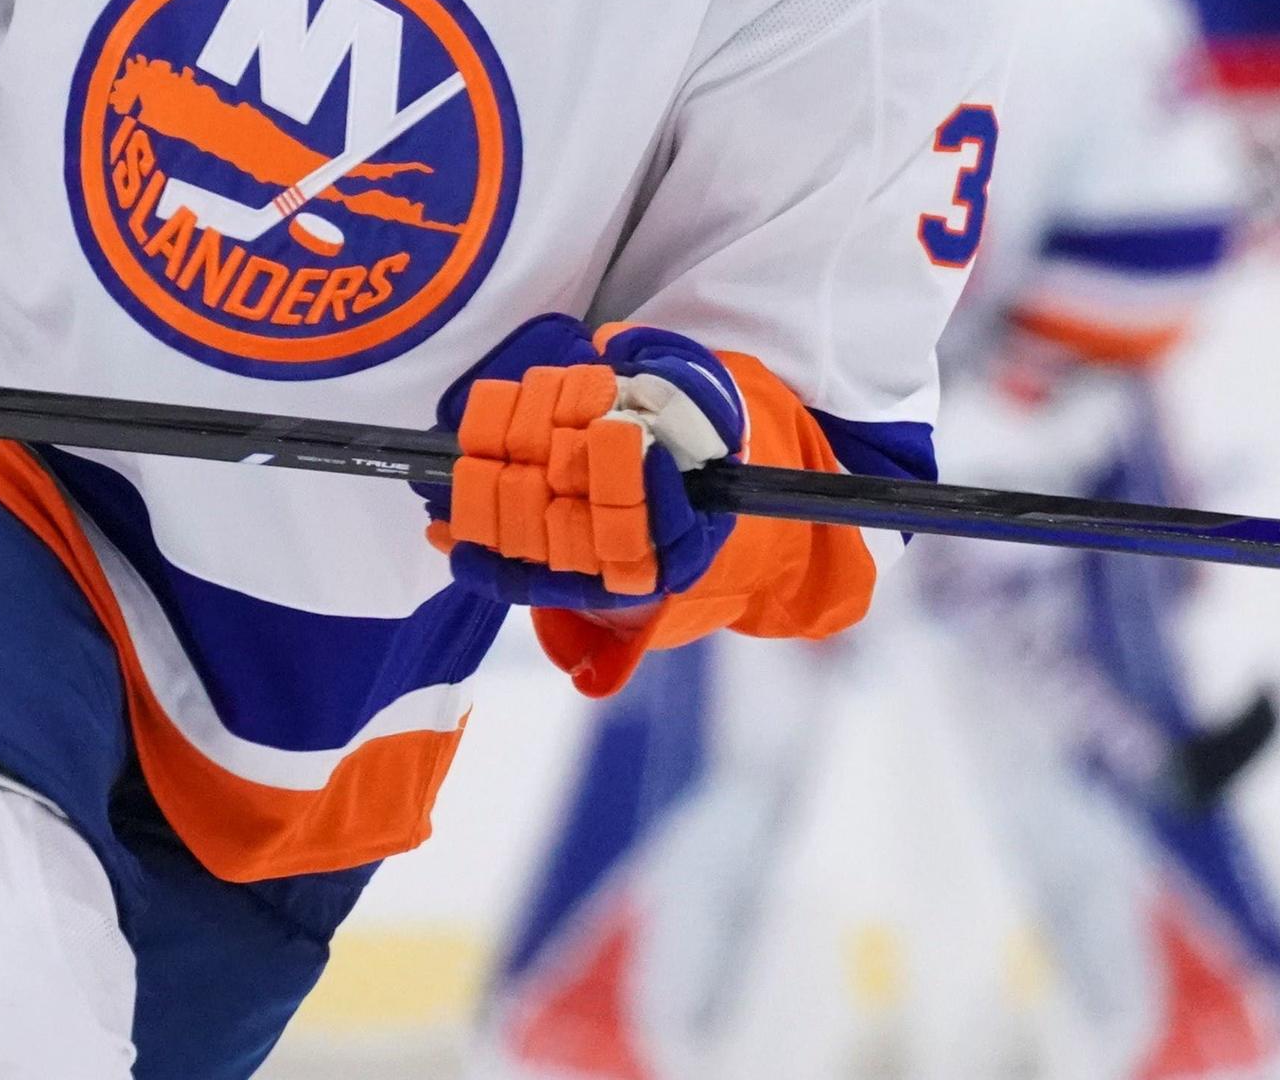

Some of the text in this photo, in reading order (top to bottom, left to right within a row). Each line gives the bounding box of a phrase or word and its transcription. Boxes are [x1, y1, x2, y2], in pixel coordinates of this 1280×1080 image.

[110, 115, 410, 326] ISLANDERS
[918, 104, 999, 268] 3
[352, 457, 410, 470] TRUE
